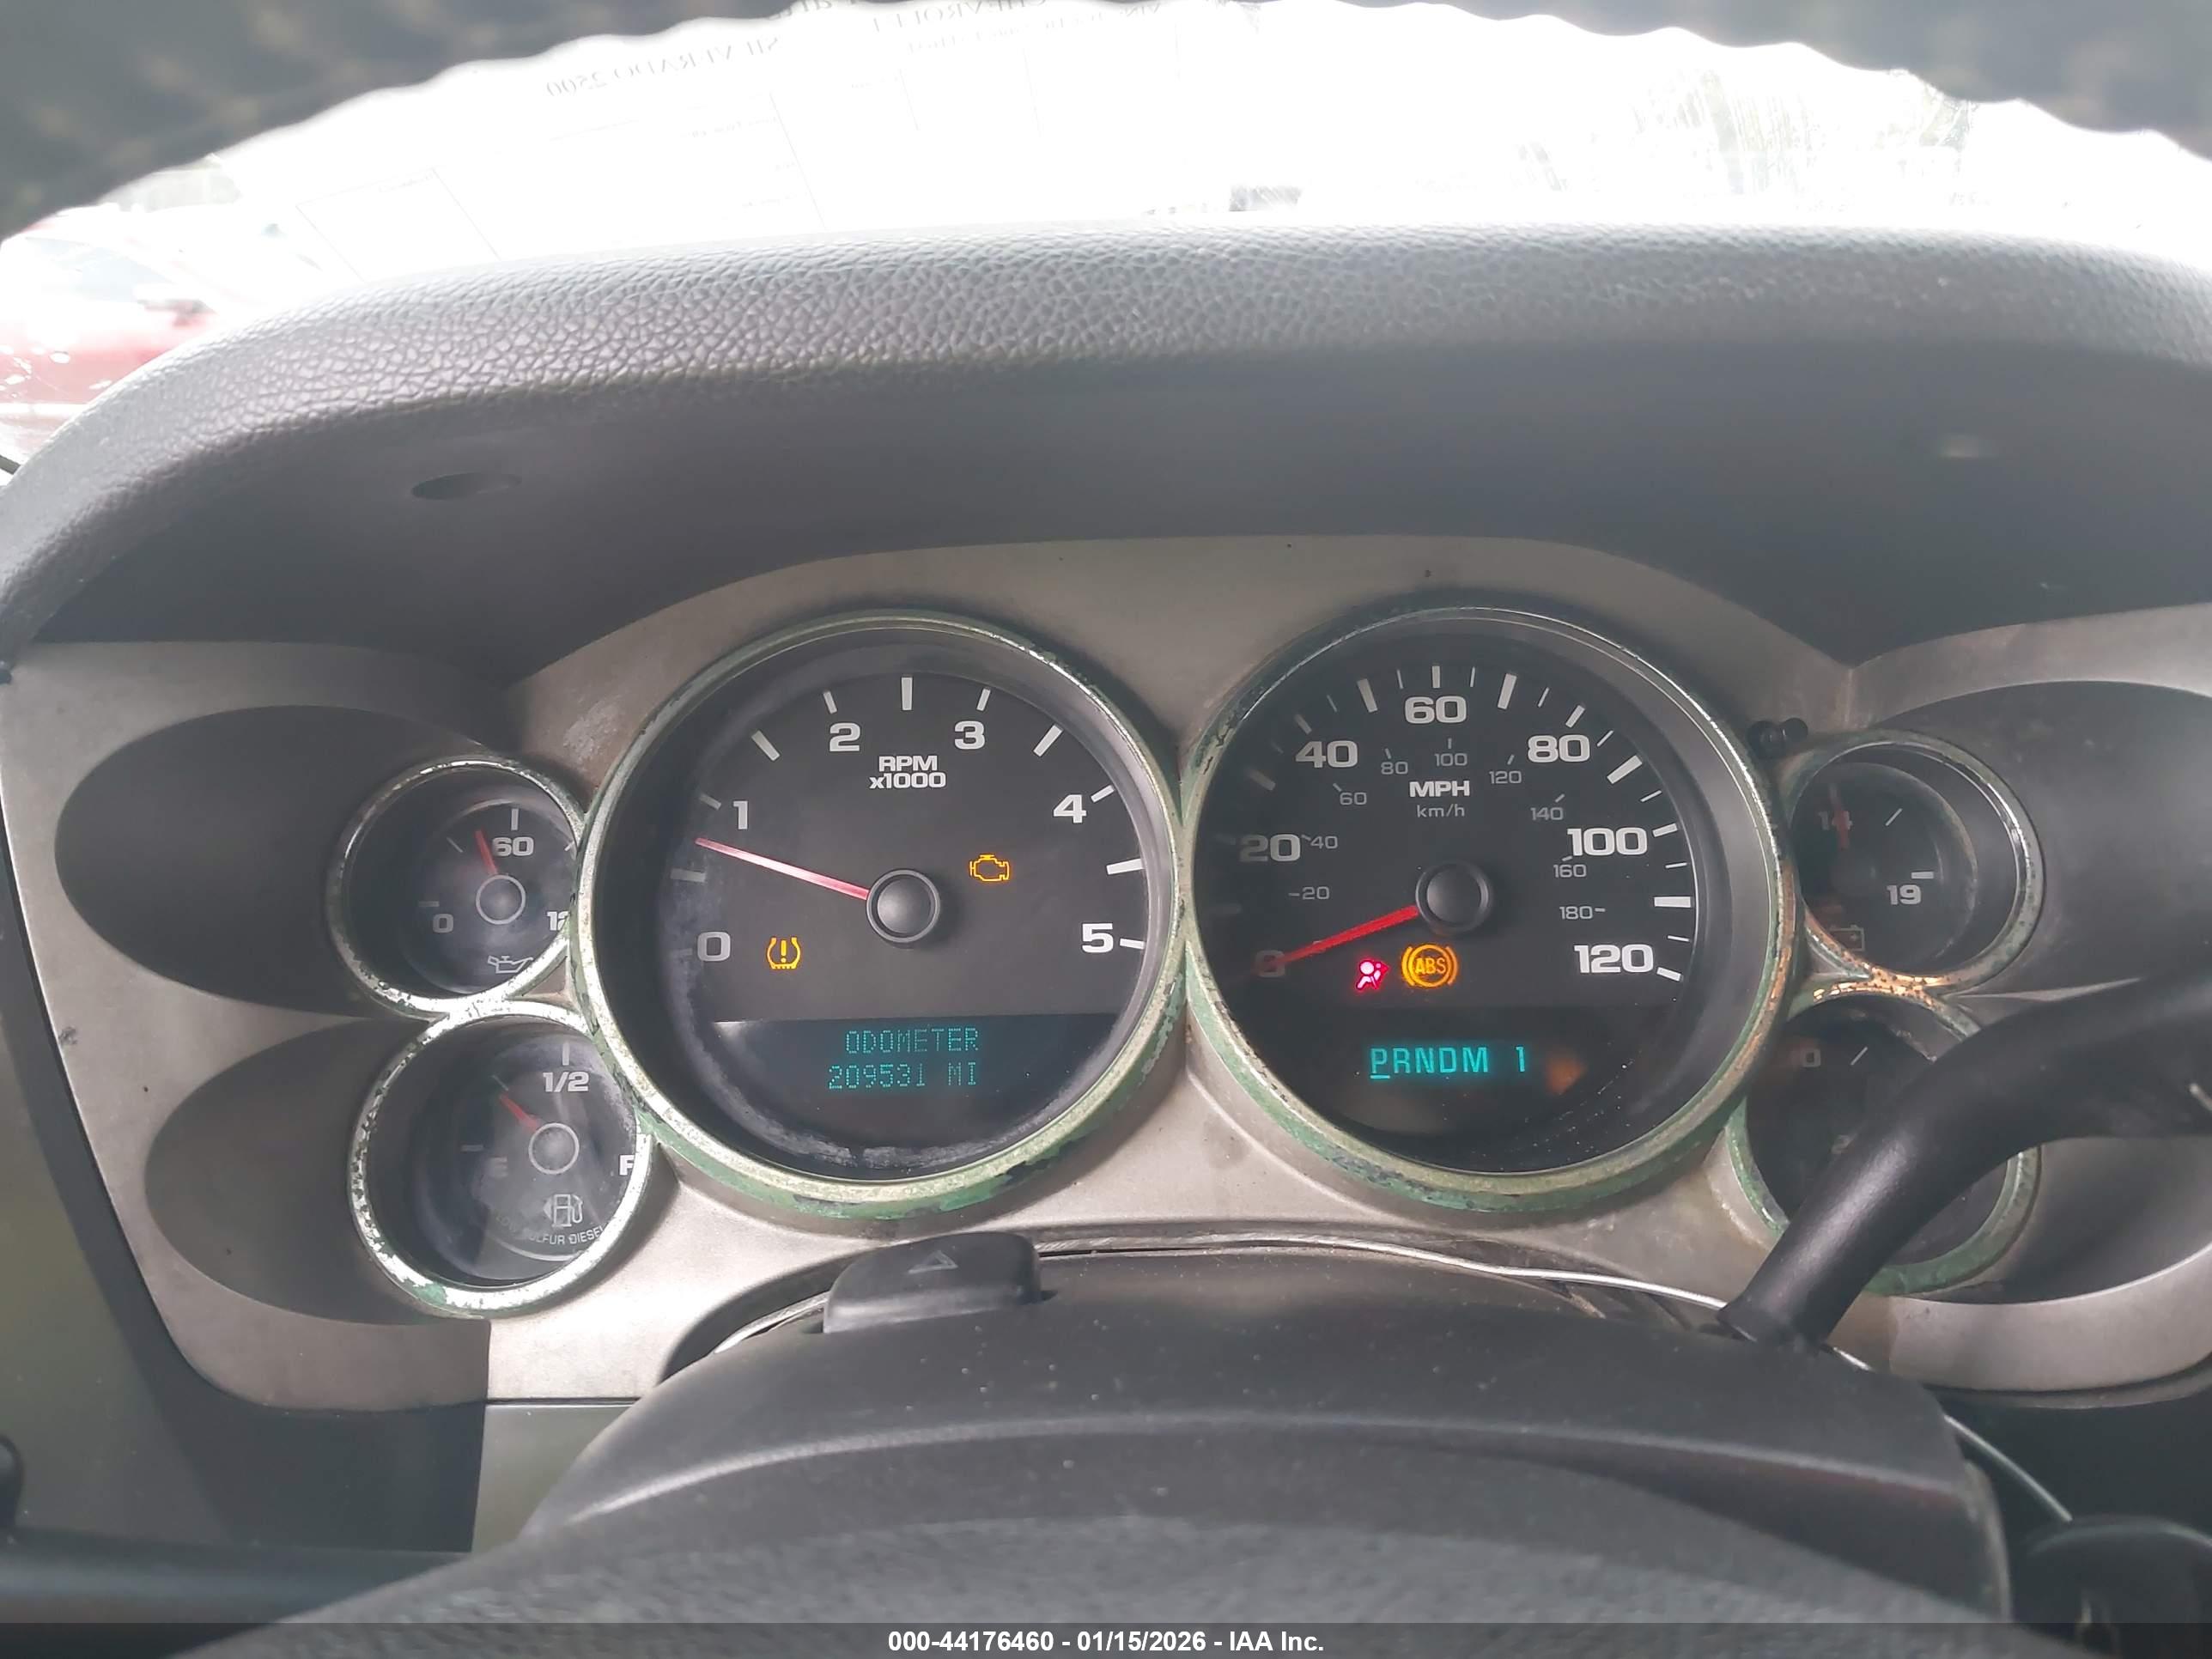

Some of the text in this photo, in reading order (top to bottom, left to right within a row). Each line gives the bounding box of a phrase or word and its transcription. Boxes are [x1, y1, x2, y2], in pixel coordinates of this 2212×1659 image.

[1405, 696, 1467, 723] 60
[830, 723, 860, 751] 2
[954, 721, 986, 749] 3
[1296, 741, 1358, 768] 40
[1434, 752, 1468, 766] 100
[1528, 735, 1589, 763] 80
[878, 756, 938, 772] RPM
[1380, 761, 1408, 775] 80
[869, 772, 946, 789] x1000
[1489, 770, 1522, 783] 120
[1339, 792, 1367, 805] 60
[1409, 781, 1470, 797] MPH
[733, 801, 748, 830] 1
[1053, 795, 1086, 823] 4
[1417, 803, 1465, 817] km/h
[1531, 806, 1564, 821] 140
[492, 836, 534, 857] 60
[1240, 836, 1301, 861] 20
[1310, 836, 1338, 849] 40
[1567, 828, 1648, 855] 100
[1553, 865, 1586, 878] 160
[1302, 886, 1330, 900] 20
[1887, 884, 1922, 905] 19
[433, 914, 454, 933] 0
[1559, 906, 1593, 920] 180
[697, 932, 731, 962] 0
[1082, 923, 1114, 953] 5
[1415, 957, 1446, 975] ABS
[1575, 945, 1653, 973] 120
[846, 1028, 978, 1054] ODOMETER
[1370, 1046, 1525, 1074] PRNDM 1
[543, 1072, 589, 1092] 1/2
[829, 1061, 976, 1089] 209531 MI
